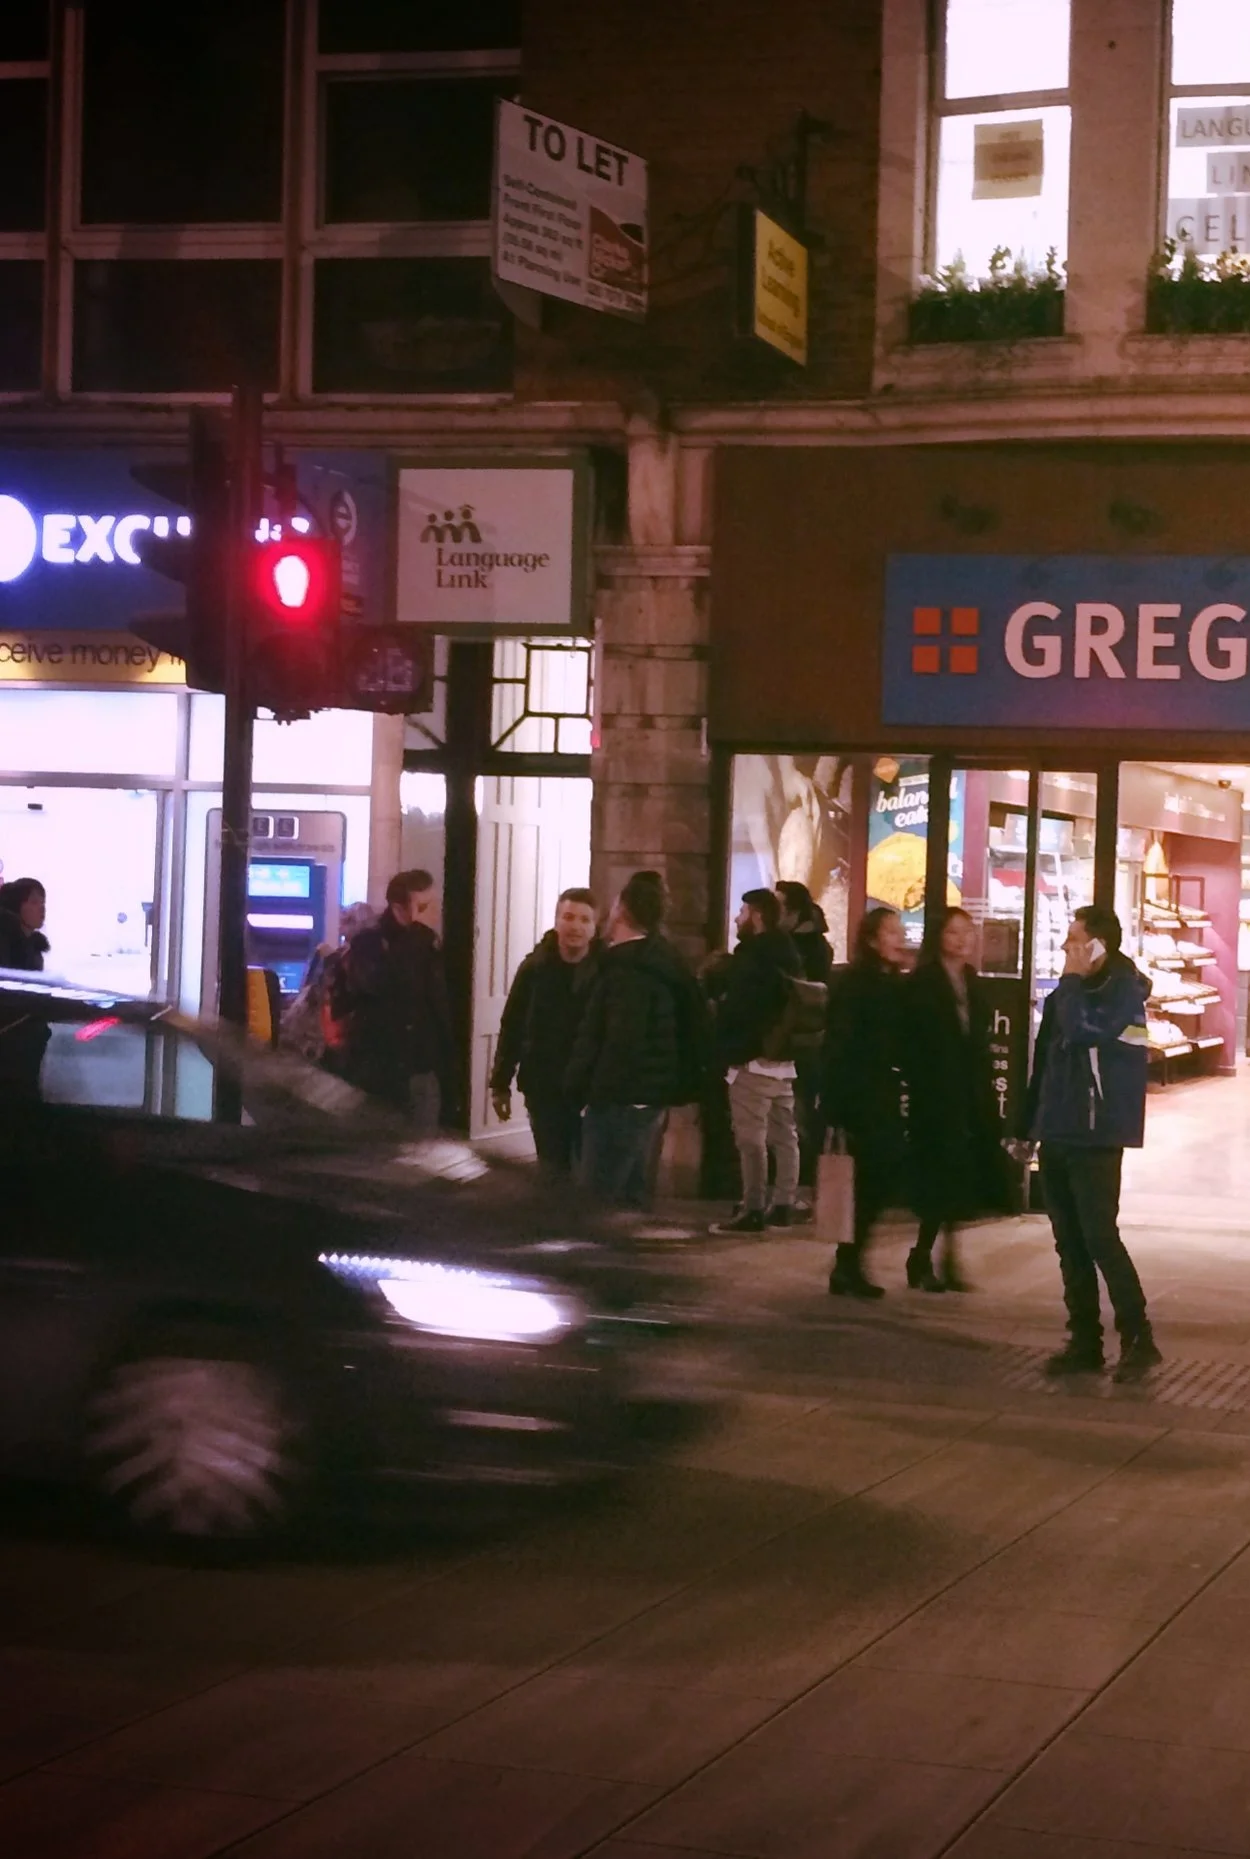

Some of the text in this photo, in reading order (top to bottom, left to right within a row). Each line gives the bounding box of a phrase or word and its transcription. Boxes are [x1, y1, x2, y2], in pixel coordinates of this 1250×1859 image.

[523, 114, 629, 187] TO LET
[435, 547, 551, 574] Language
[435, 569, 489, 589] Link
[69, 643, 162, 673] money
